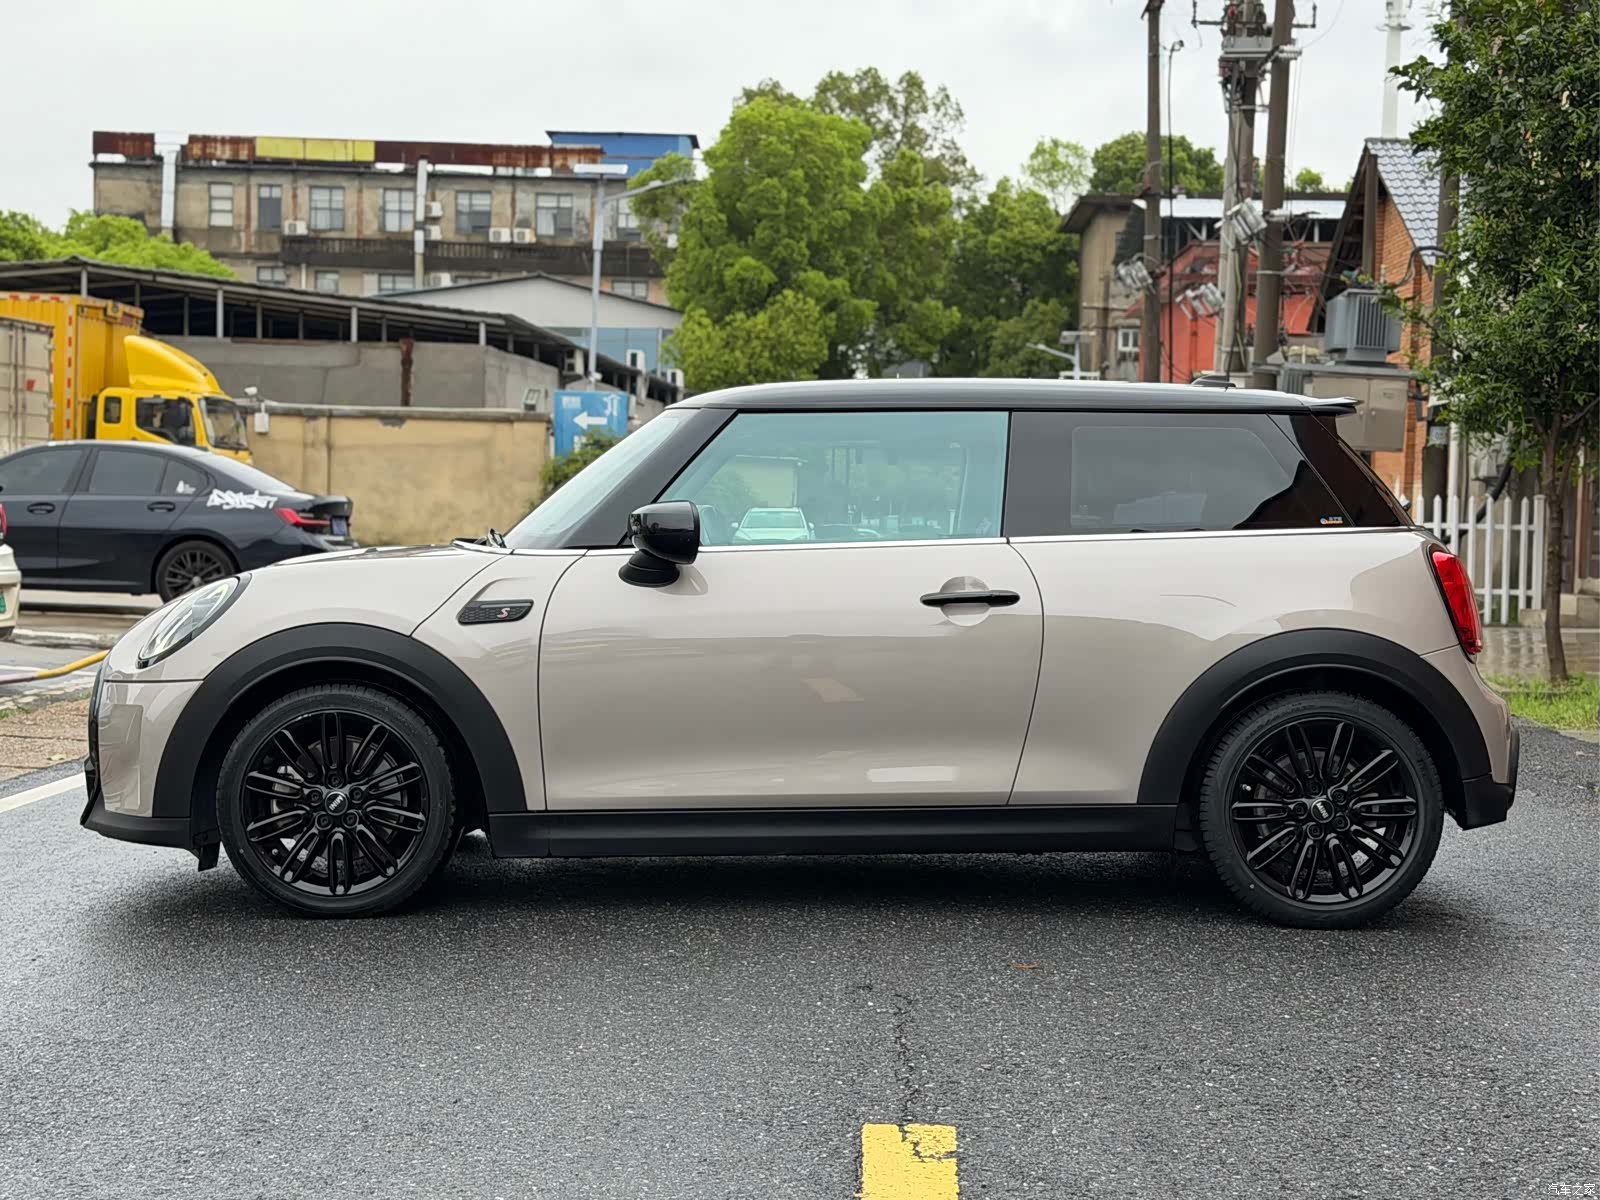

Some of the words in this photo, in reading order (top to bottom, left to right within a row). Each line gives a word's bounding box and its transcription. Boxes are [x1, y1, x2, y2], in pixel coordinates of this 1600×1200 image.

[497, 607, 511, 619] S
[328, 794, 344, 812] MINI
[1315, 801, 1330, 819] MINI
